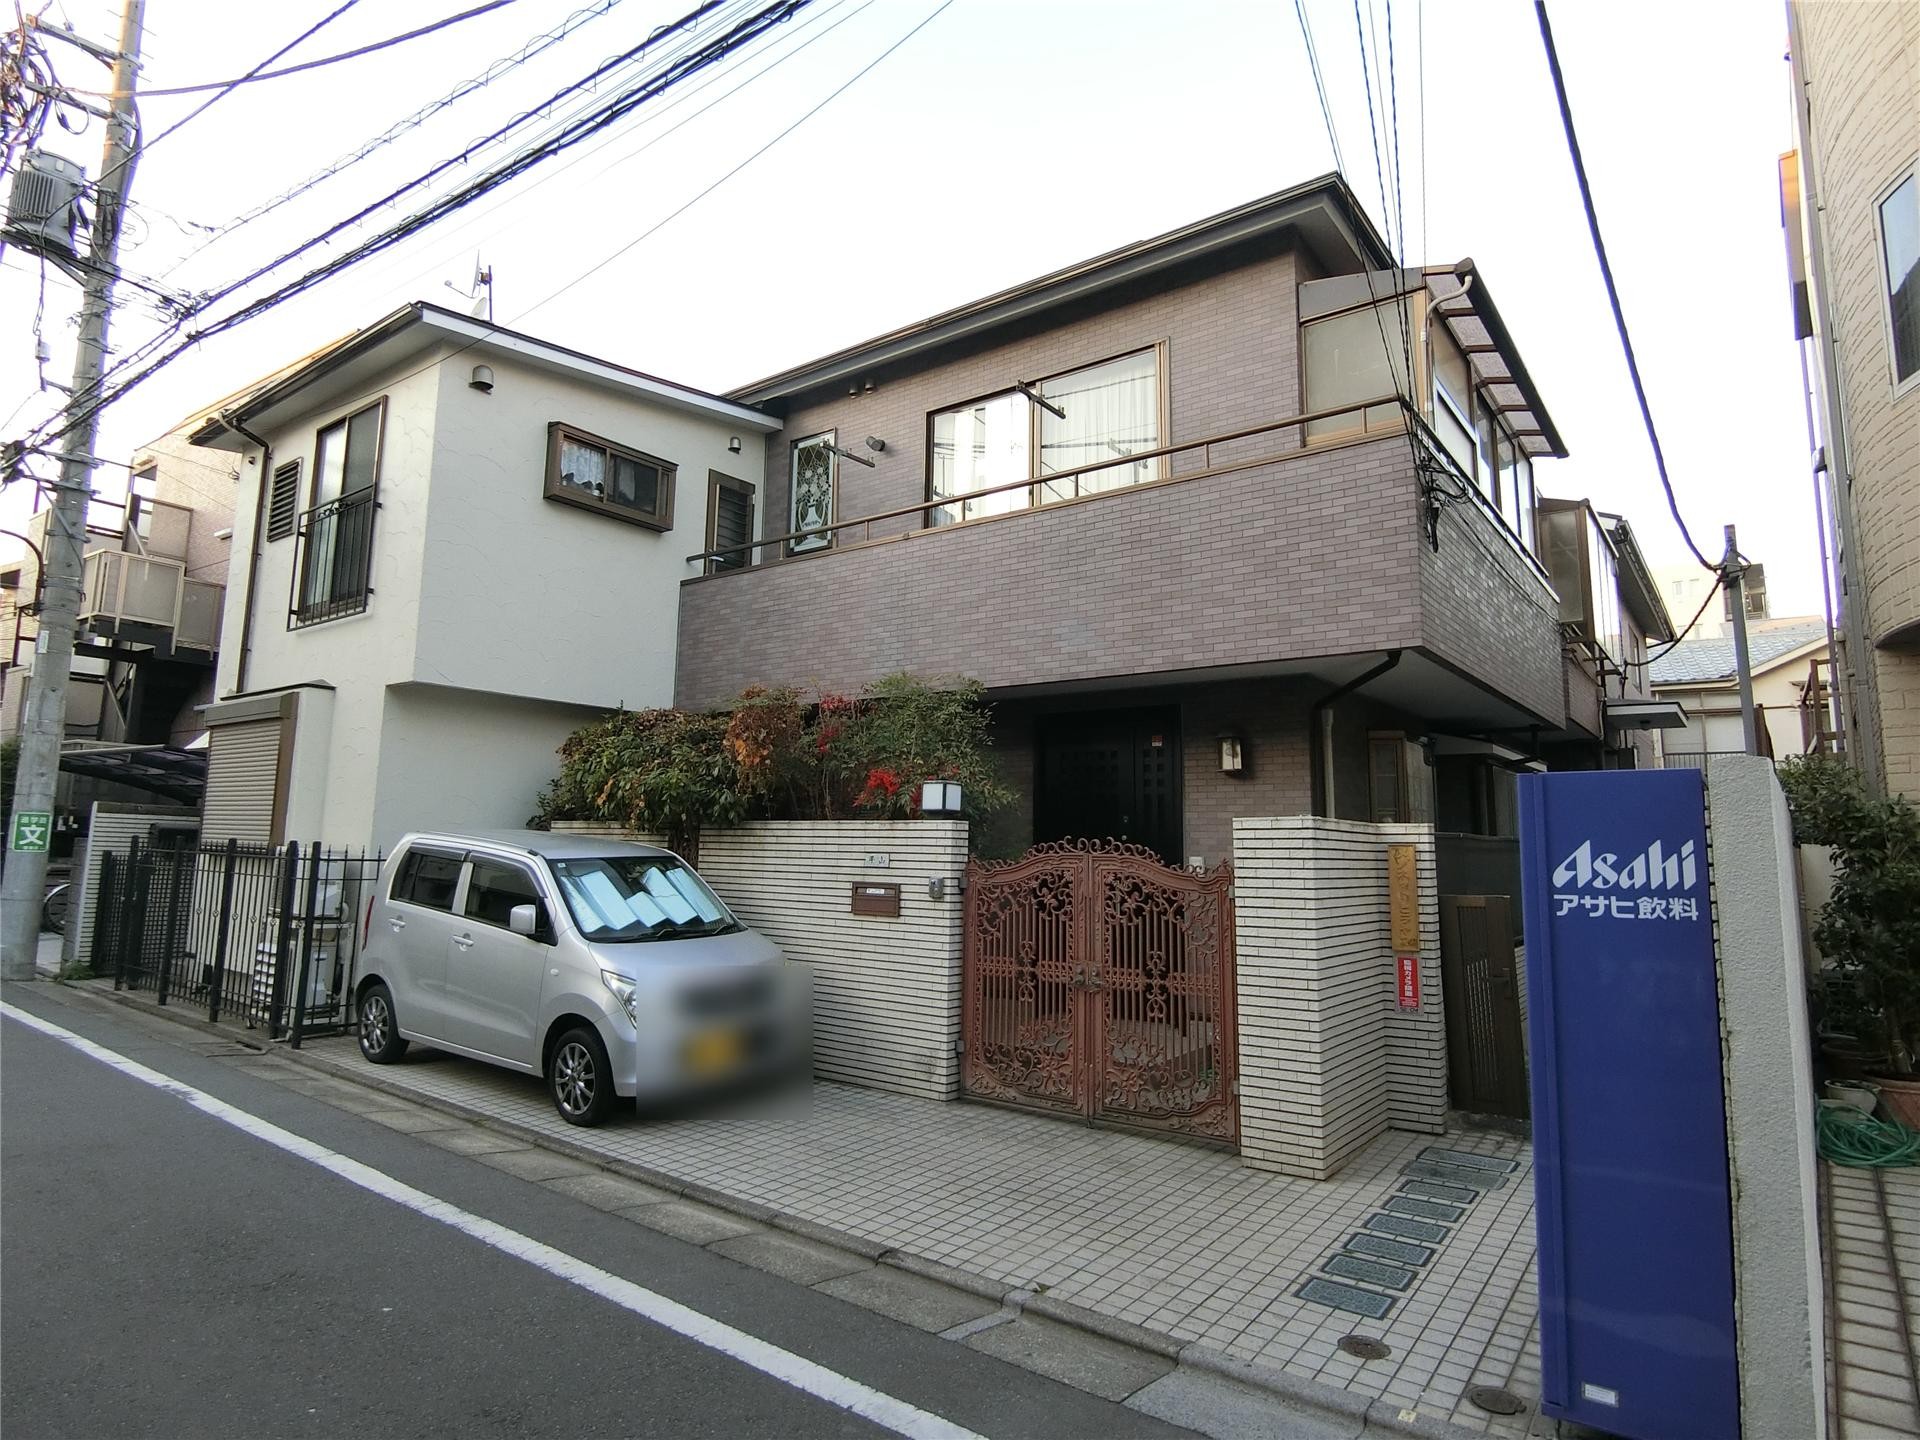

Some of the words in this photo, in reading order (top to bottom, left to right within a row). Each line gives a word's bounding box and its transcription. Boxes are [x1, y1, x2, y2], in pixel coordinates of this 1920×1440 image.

[18, 824, 46, 845] 文
[1552, 839, 1696, 890] Asahi
[1553, 894, 1699, 921] アサヒ飲料
